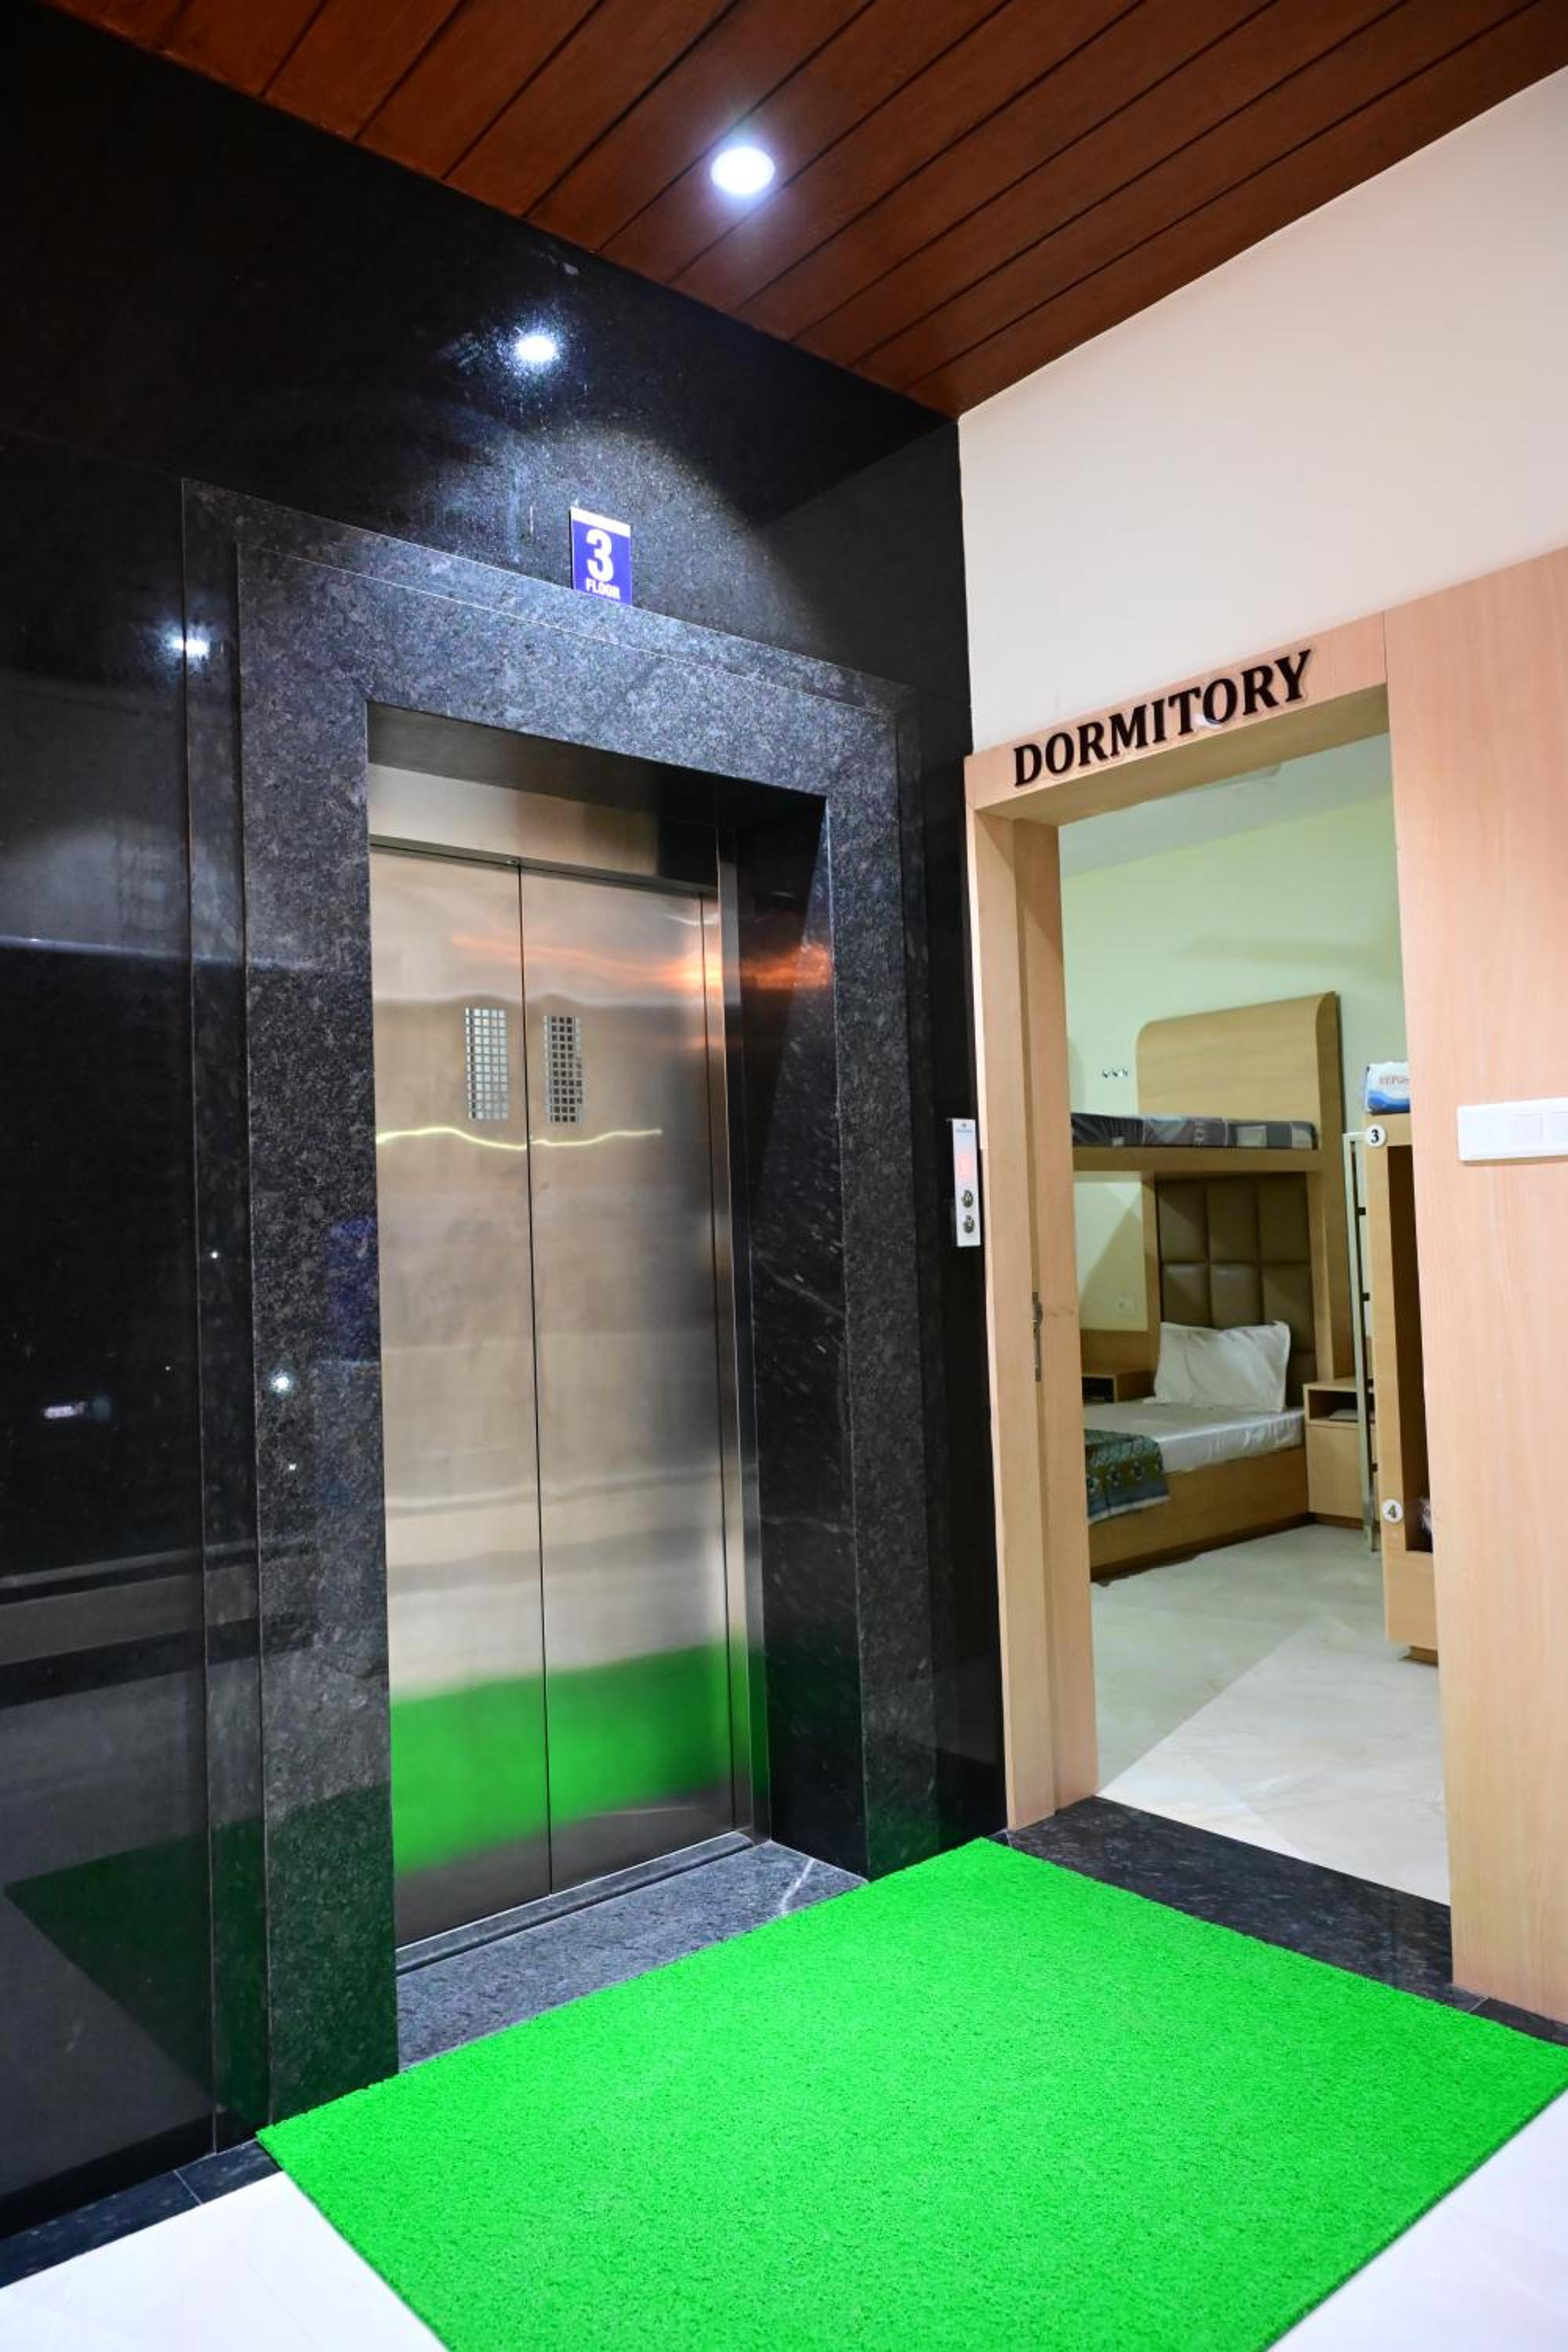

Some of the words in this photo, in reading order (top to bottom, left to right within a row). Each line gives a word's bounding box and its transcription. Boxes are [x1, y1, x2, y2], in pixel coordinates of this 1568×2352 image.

[586, 528, 615, 583] 3
[584, 578, 621, 600] FLOOR
[1014, 649, 1312, 786] DORMITORY
[1370, 1128, 1379, 1143] 3
[1387, 1504, 1397, 1519] 4
